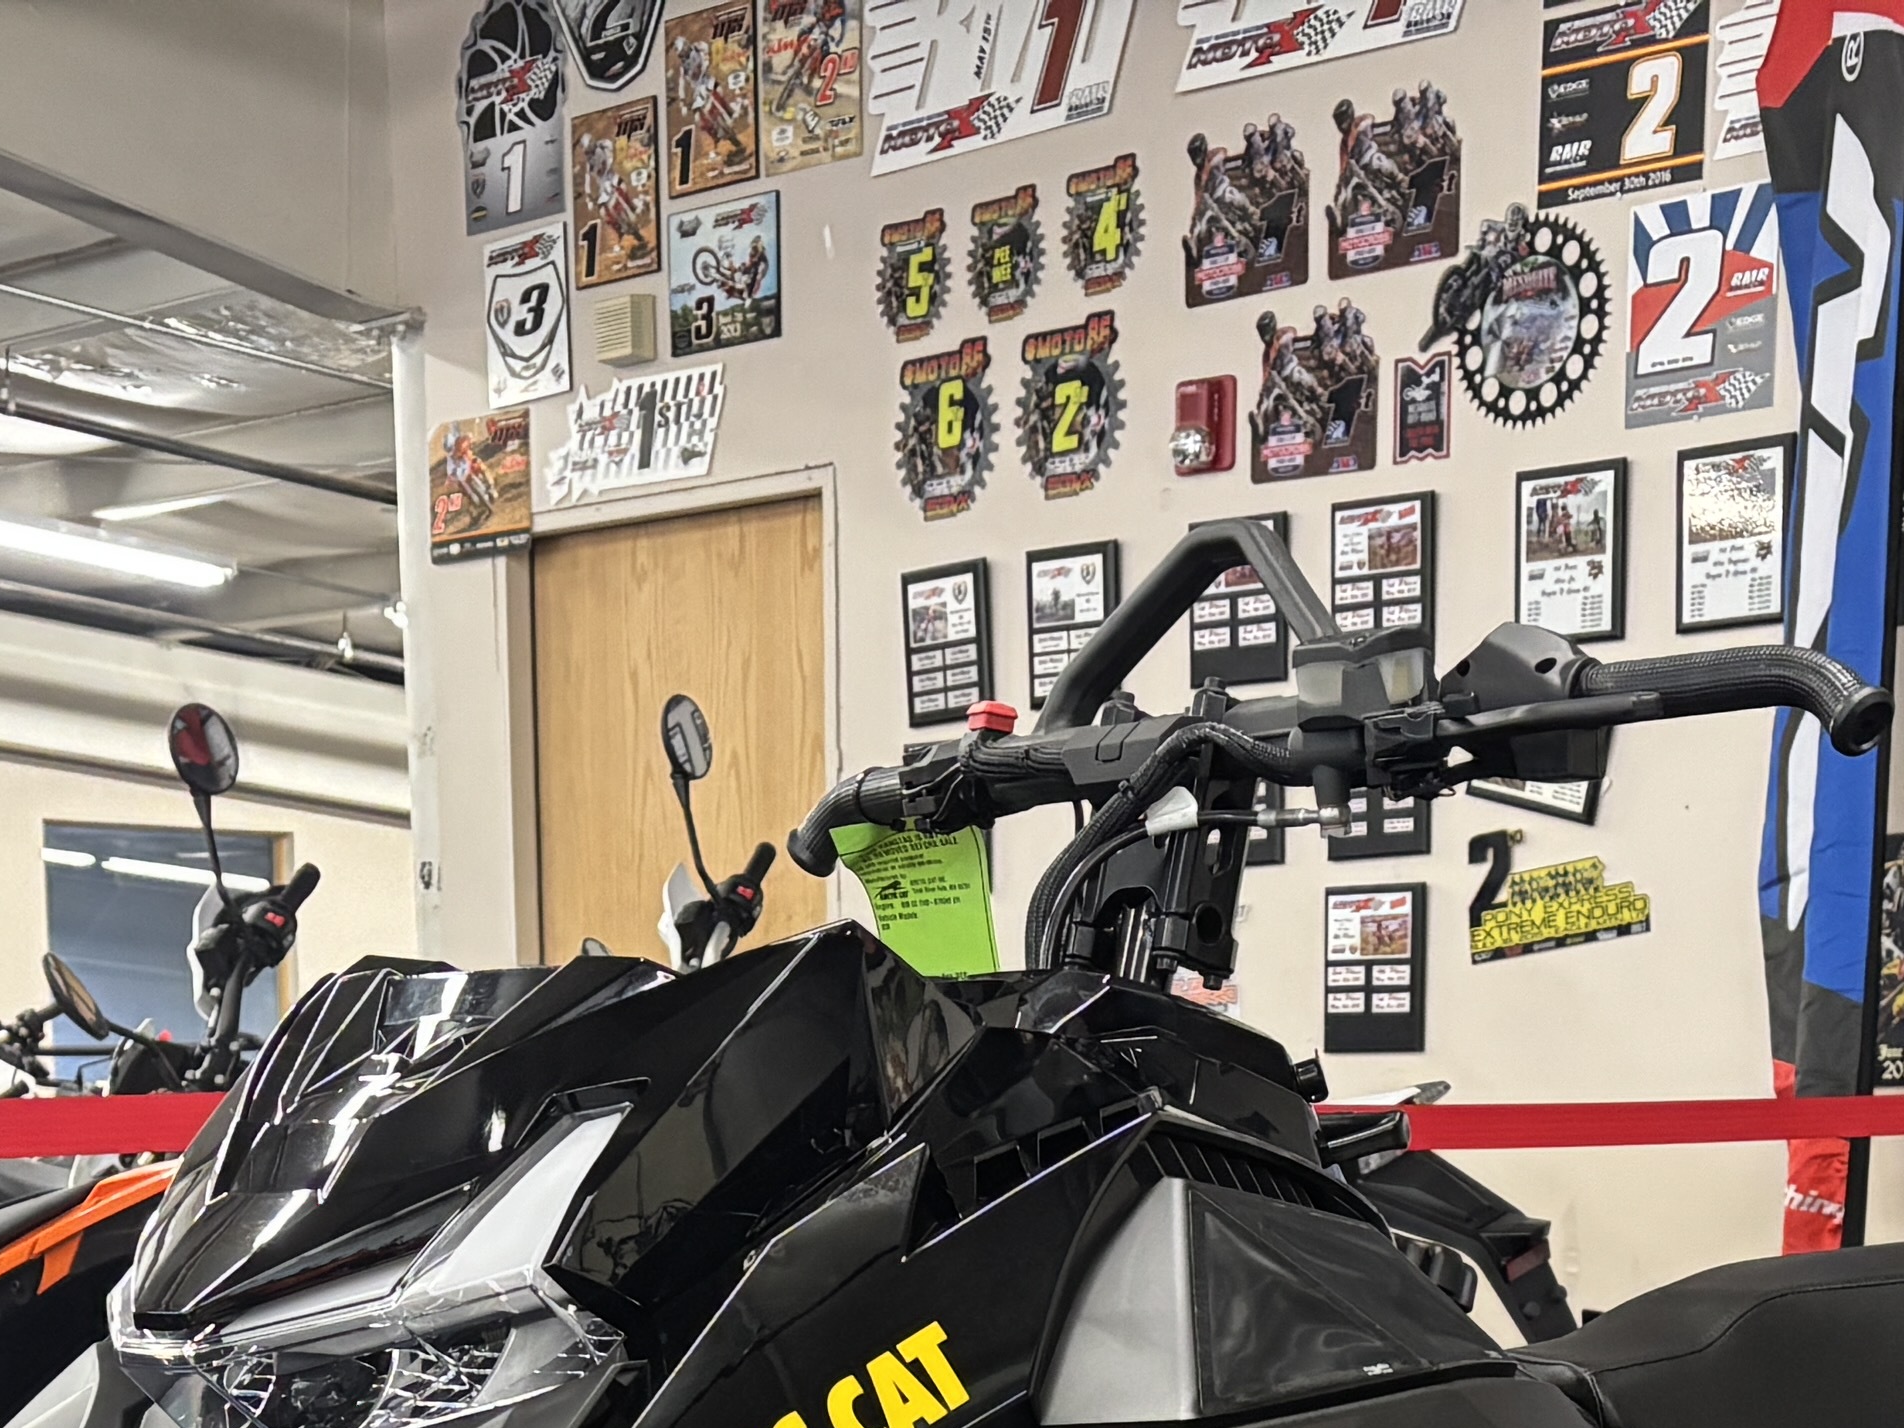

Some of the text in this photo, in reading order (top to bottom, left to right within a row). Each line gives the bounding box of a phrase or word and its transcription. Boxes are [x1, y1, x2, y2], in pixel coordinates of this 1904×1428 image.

[974, 46, 986, 80] MAY
[1620, 51, 1682, 164] 2
[501, 139, 527, 214] 1
[672, 125, 695, 188] 1
[1568, 170, 1672, 200] September 30th 2016
[579, 219, 601, 279] 1
[1093, 187, 1121, 262] 4
[513, 282, 550, 336] 3
[907, 246, 934, 318] 5
[1637, 227, 1724, 377] 2
[691, 295, 715, 343] 3
[938, 378, 964, 449] 6
[1052, 380, 1086, 453] 2
[1471, 897, 1648, 943] EXTREME ENDURO
[1483, 886, 1632, 926] PONY EXPRESS
